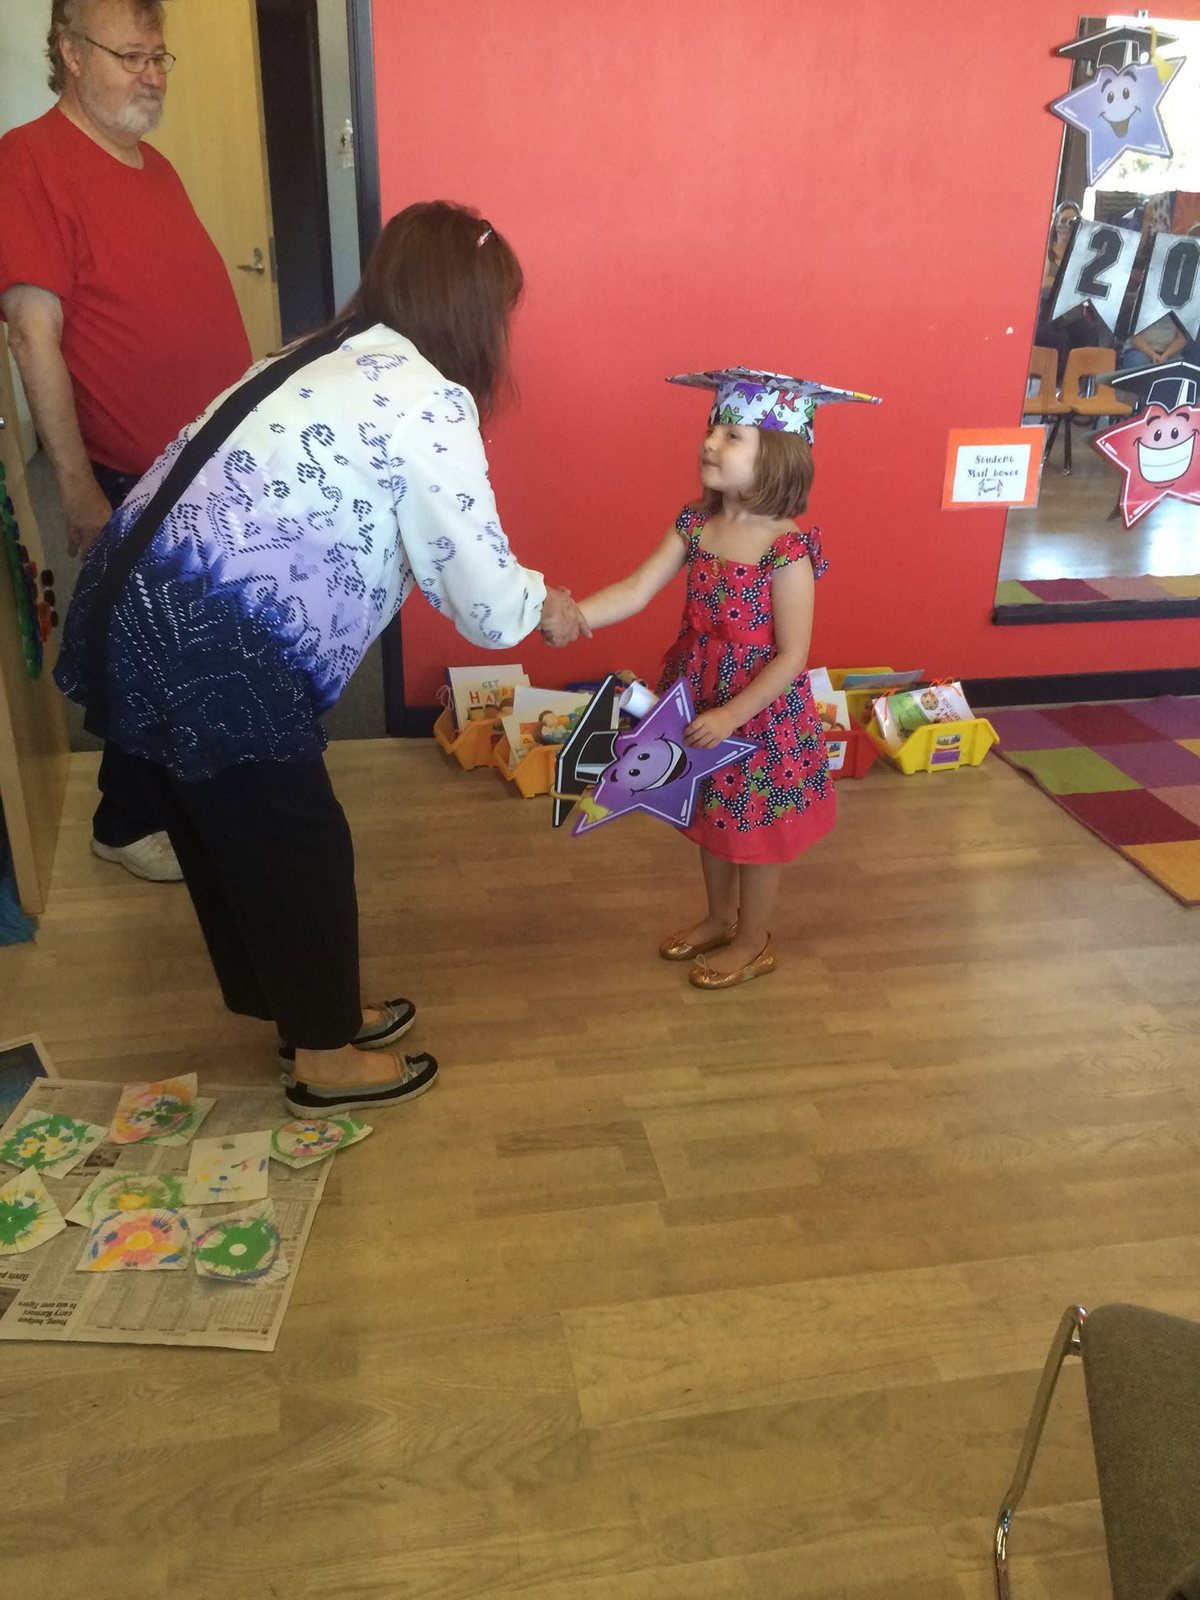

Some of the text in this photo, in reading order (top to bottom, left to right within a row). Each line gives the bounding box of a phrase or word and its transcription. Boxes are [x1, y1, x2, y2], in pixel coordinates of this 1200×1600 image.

[1075, 225, 1124, 300] 2
[975, 455, 1014, 463] Student
[968, 467, 988, 477] Mail
[482, 680, 499, 688] GET
[8, 1272, 29, 1281] Davis
